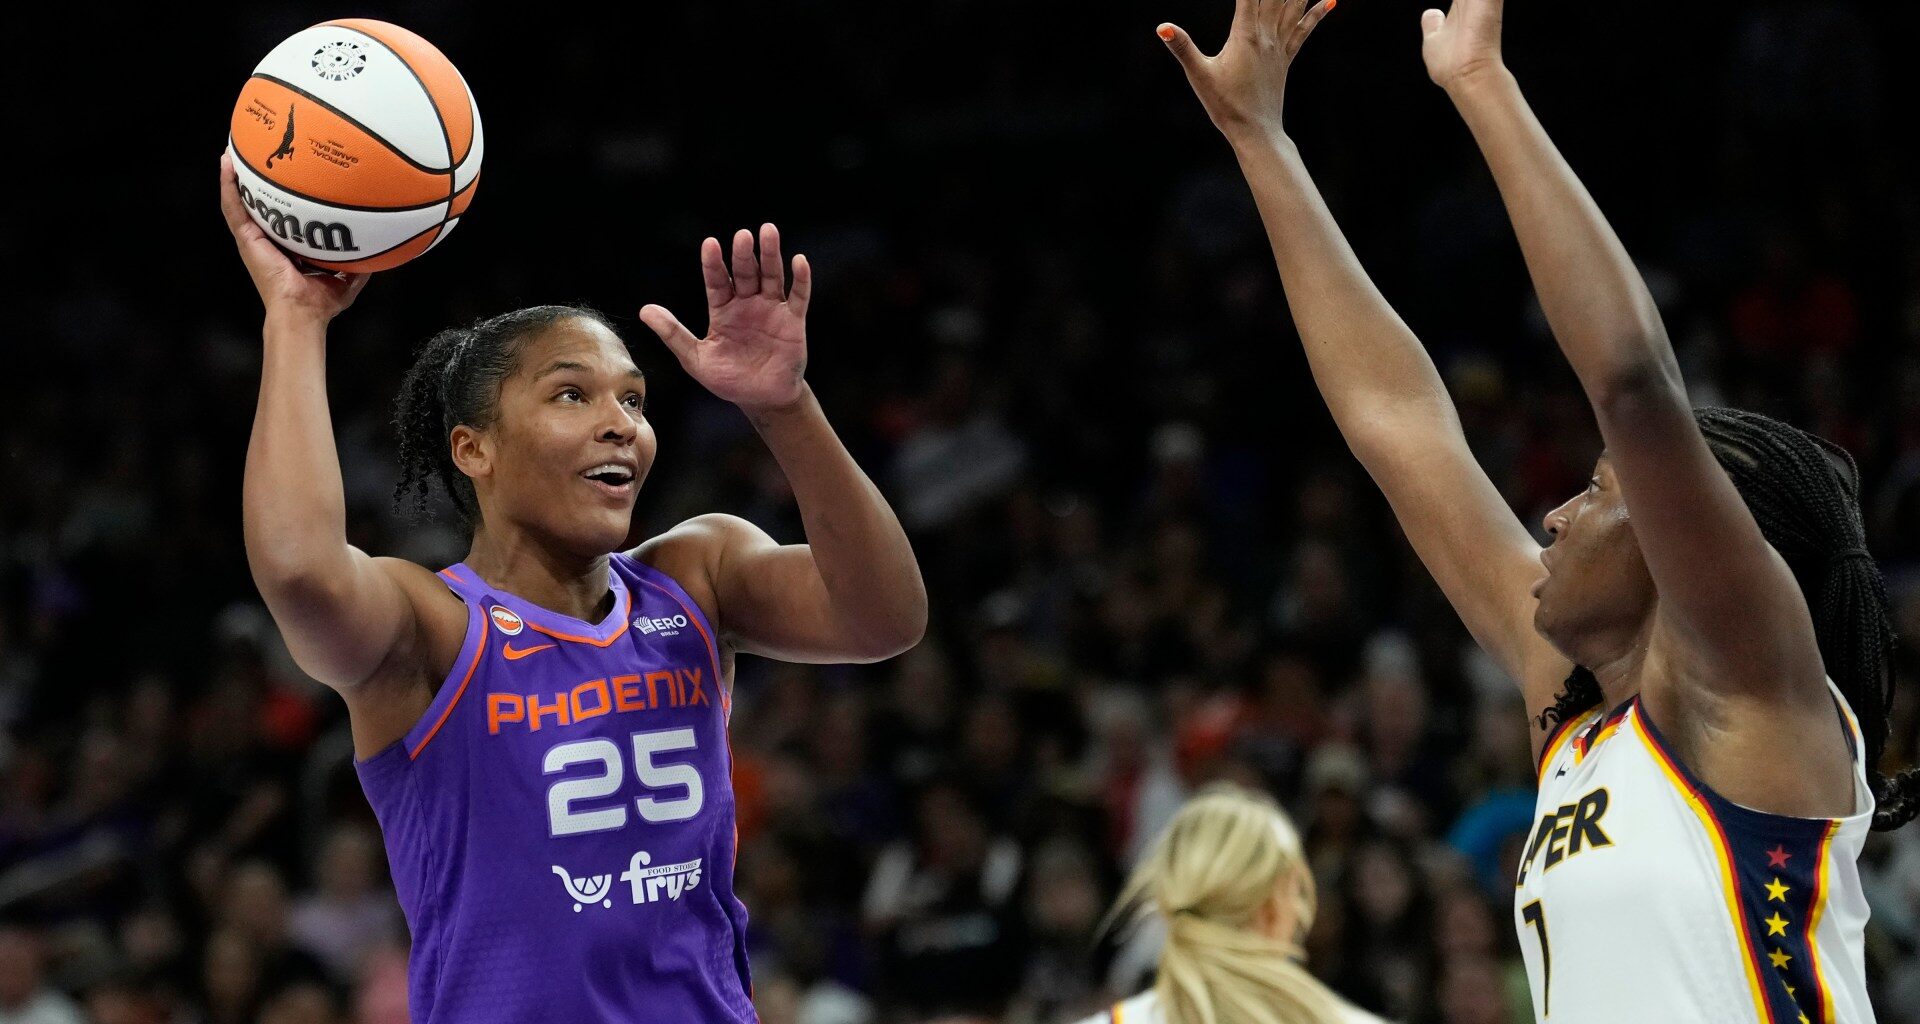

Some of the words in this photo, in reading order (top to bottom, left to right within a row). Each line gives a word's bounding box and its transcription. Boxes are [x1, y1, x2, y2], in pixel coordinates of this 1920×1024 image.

[308, 138, 330, 153] BALL
[312, 148, 350, 168] OFFICIAL
[330, 150, 359, 164] GAME
[237, 178, 360, 252] Wilso
[487, 667, 710, 735] PHOENIX
[542, 728, 704, 837] 25
[647, 866, 671, 876] FOOD
[673, 860, 698, 872] STORES
